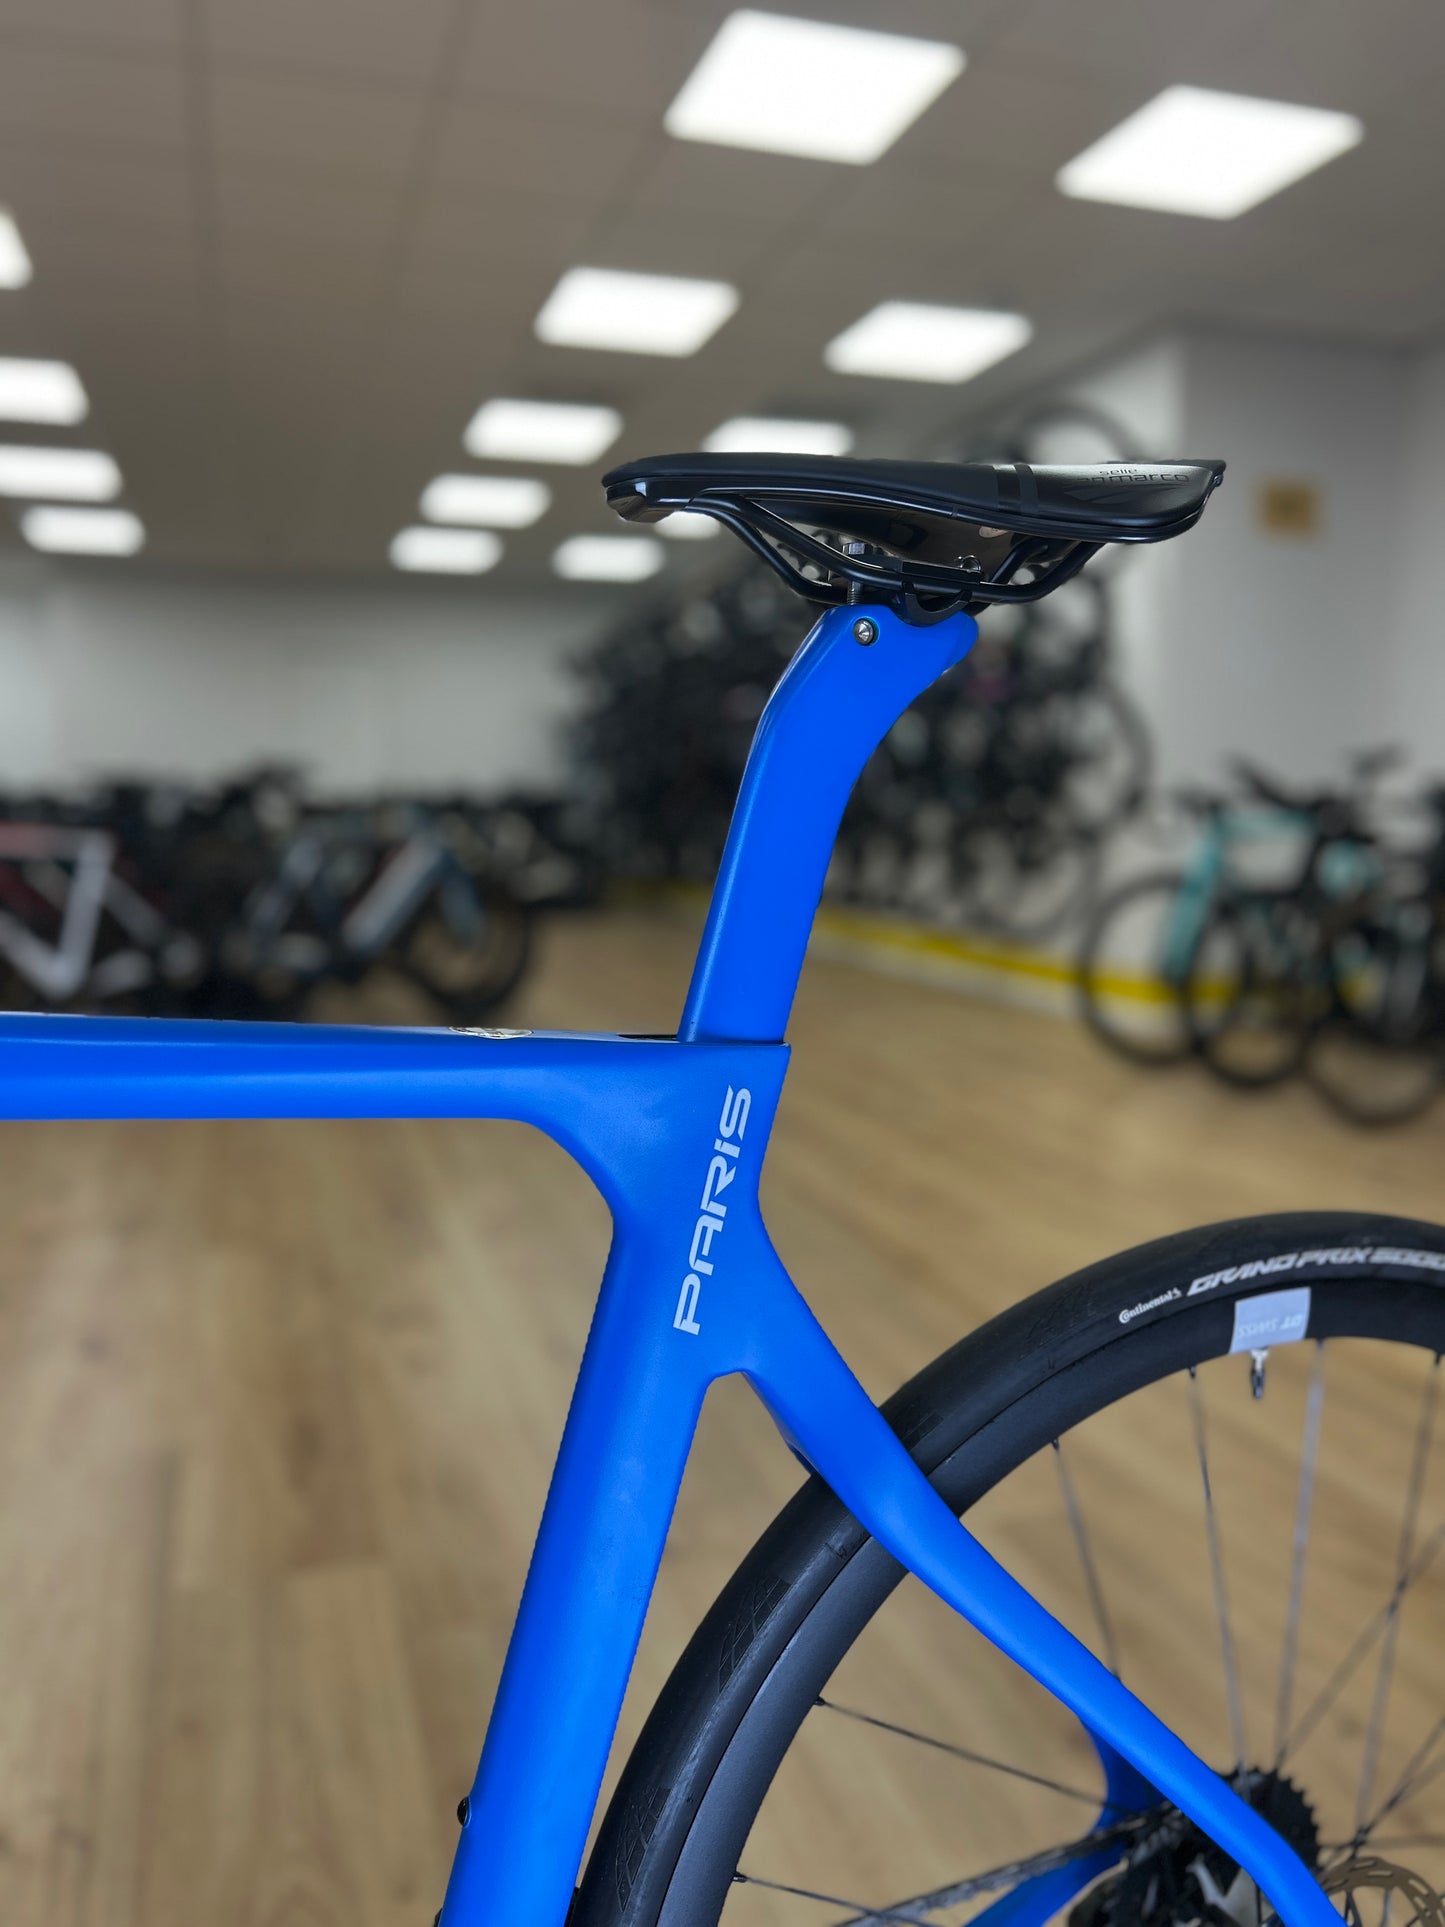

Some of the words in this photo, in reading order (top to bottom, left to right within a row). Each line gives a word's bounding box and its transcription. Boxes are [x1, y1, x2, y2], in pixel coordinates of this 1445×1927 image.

[672, 1084, 752, 1336] PARIS
[1118, 1289, 1174, 1324] Continental
[1187, 1253, 1298, 1296] GRAND
[1296, 1247, 1374, 1270] PRIX
